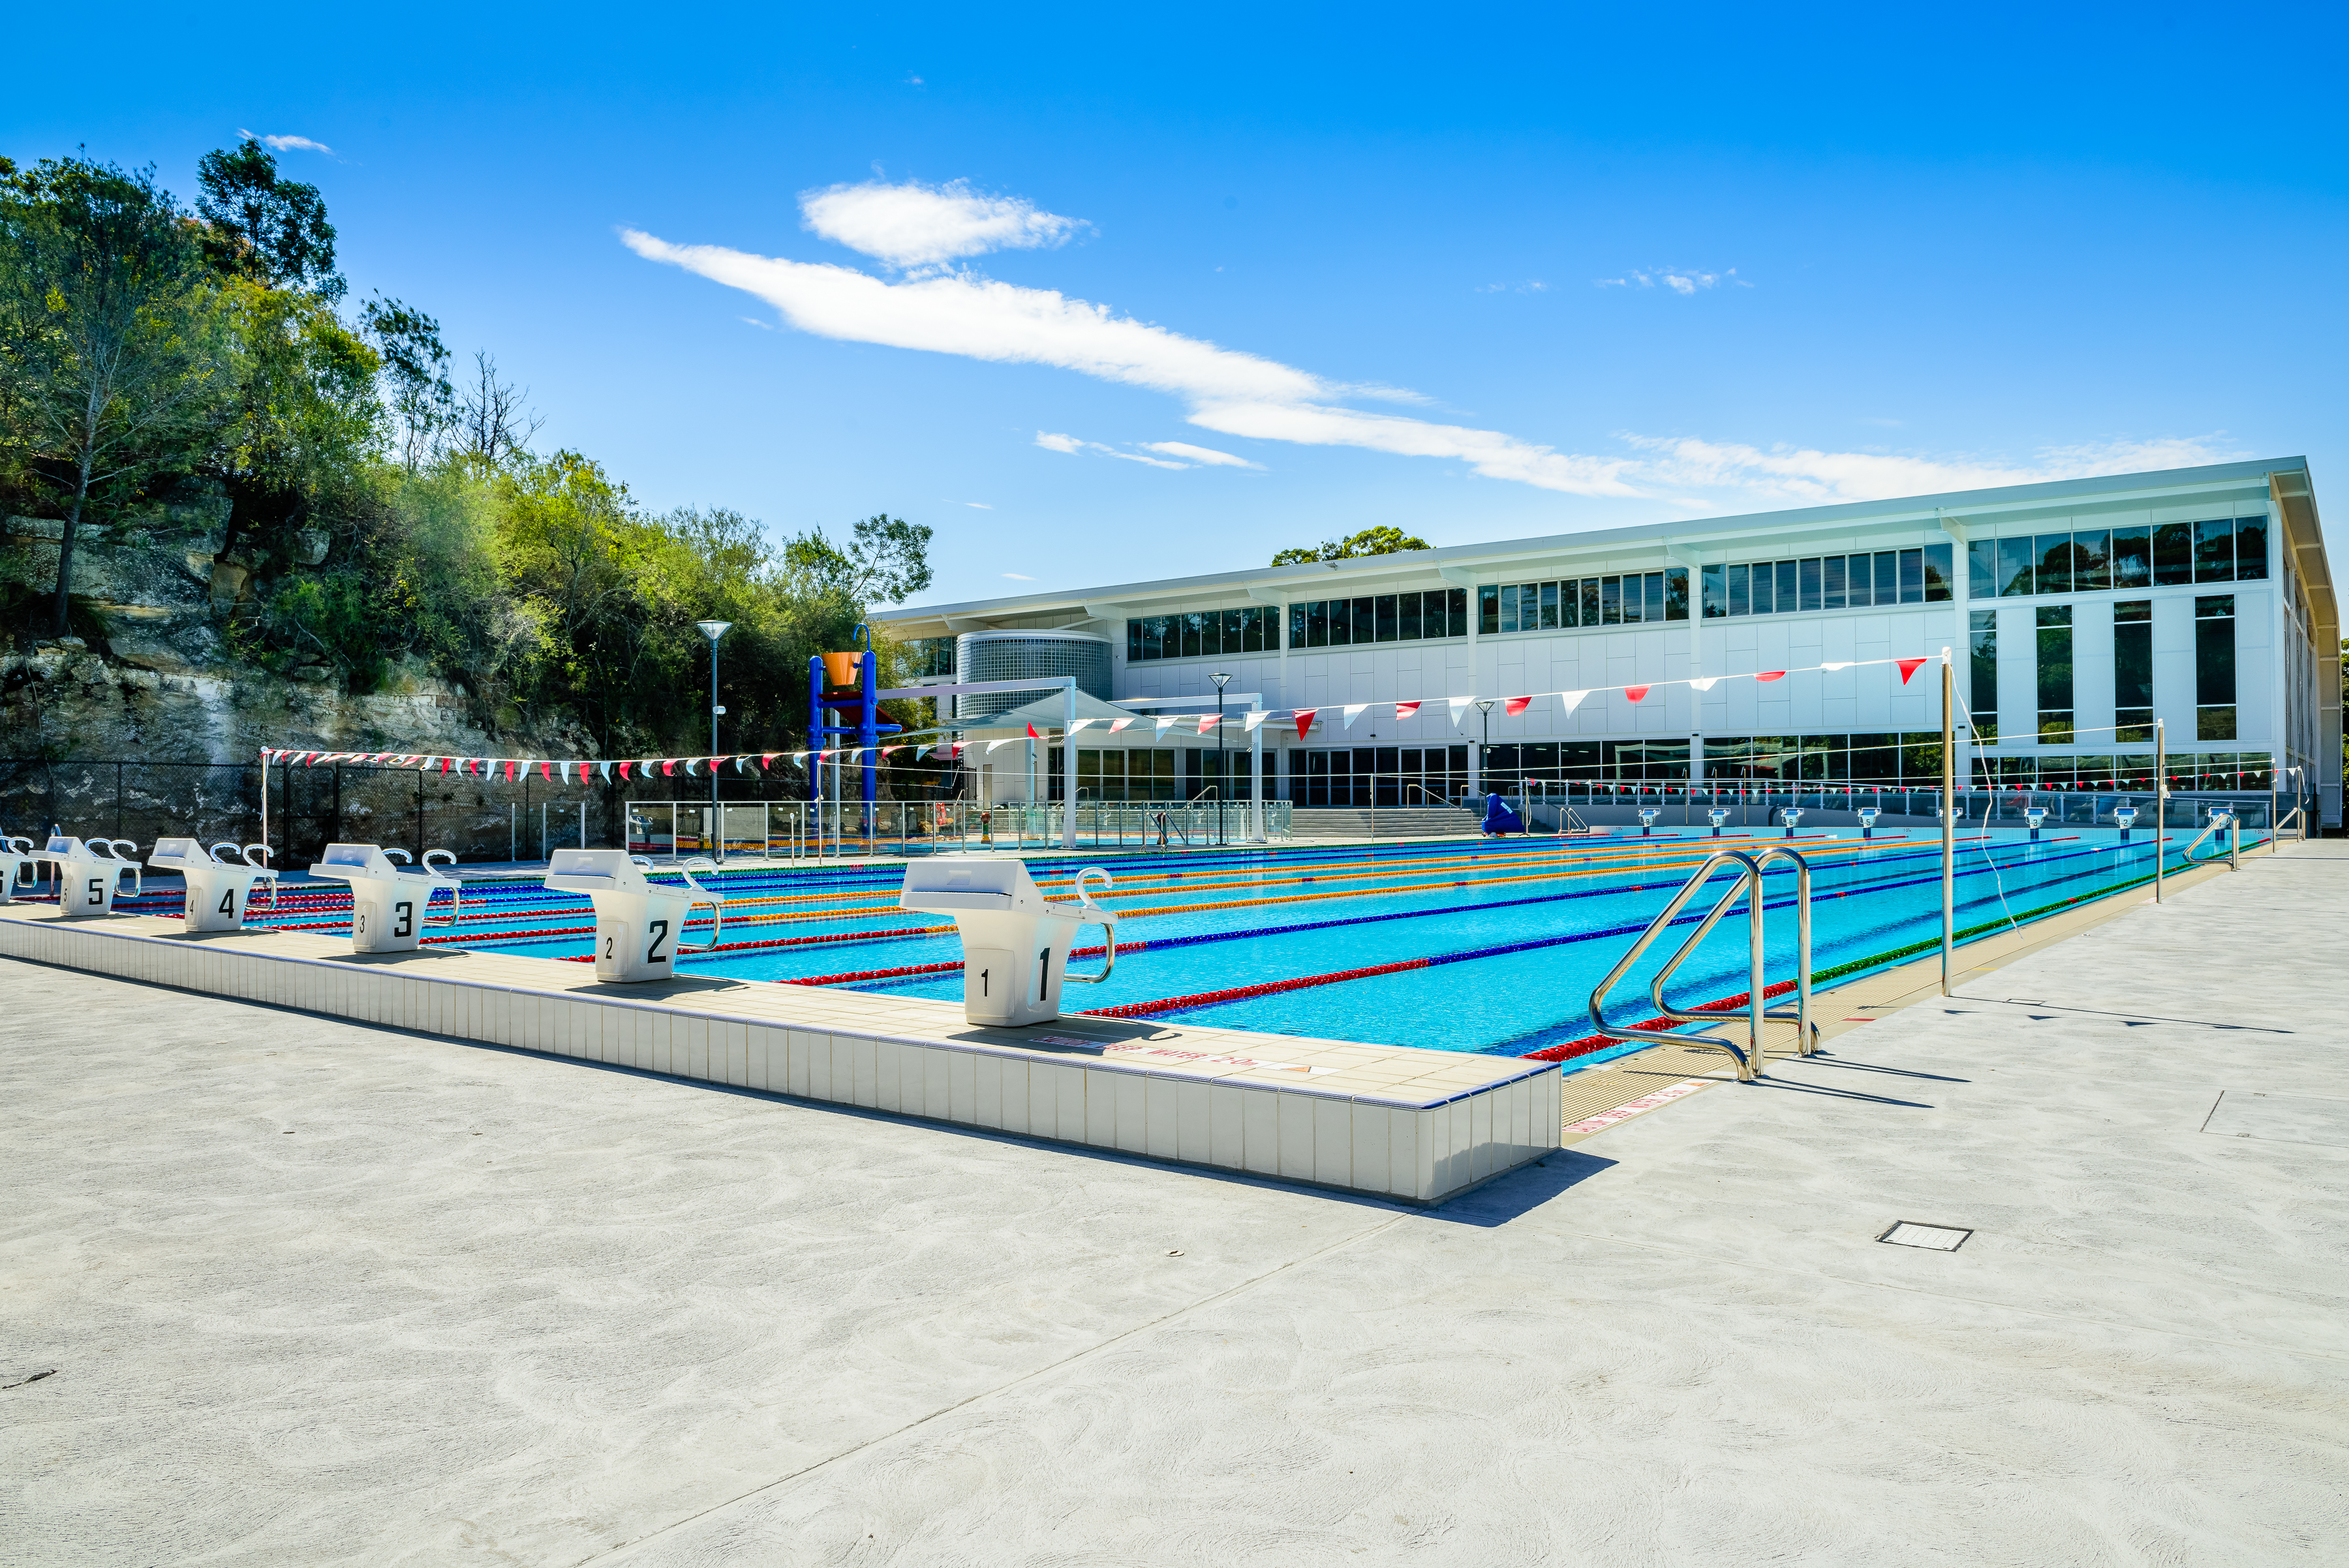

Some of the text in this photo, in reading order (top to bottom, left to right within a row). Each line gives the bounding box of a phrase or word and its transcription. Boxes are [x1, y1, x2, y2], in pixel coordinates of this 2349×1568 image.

[63, 888, 68, 902] 5
[88, 878, 104, 906] 5
[219, 888, 235, 919] 4
[189, 900, 194, 915] 4
[394, 901, 412, 938] 3
[360, 914, 365, 934] 3
[606, 936, 613, 960] 2
[647, 919, 669, 964] 2
[981, 968, 989, 997] 1
[1039, 947, 1051, 1002] 1
[1146, 1049, 1208, 1059] WATER
